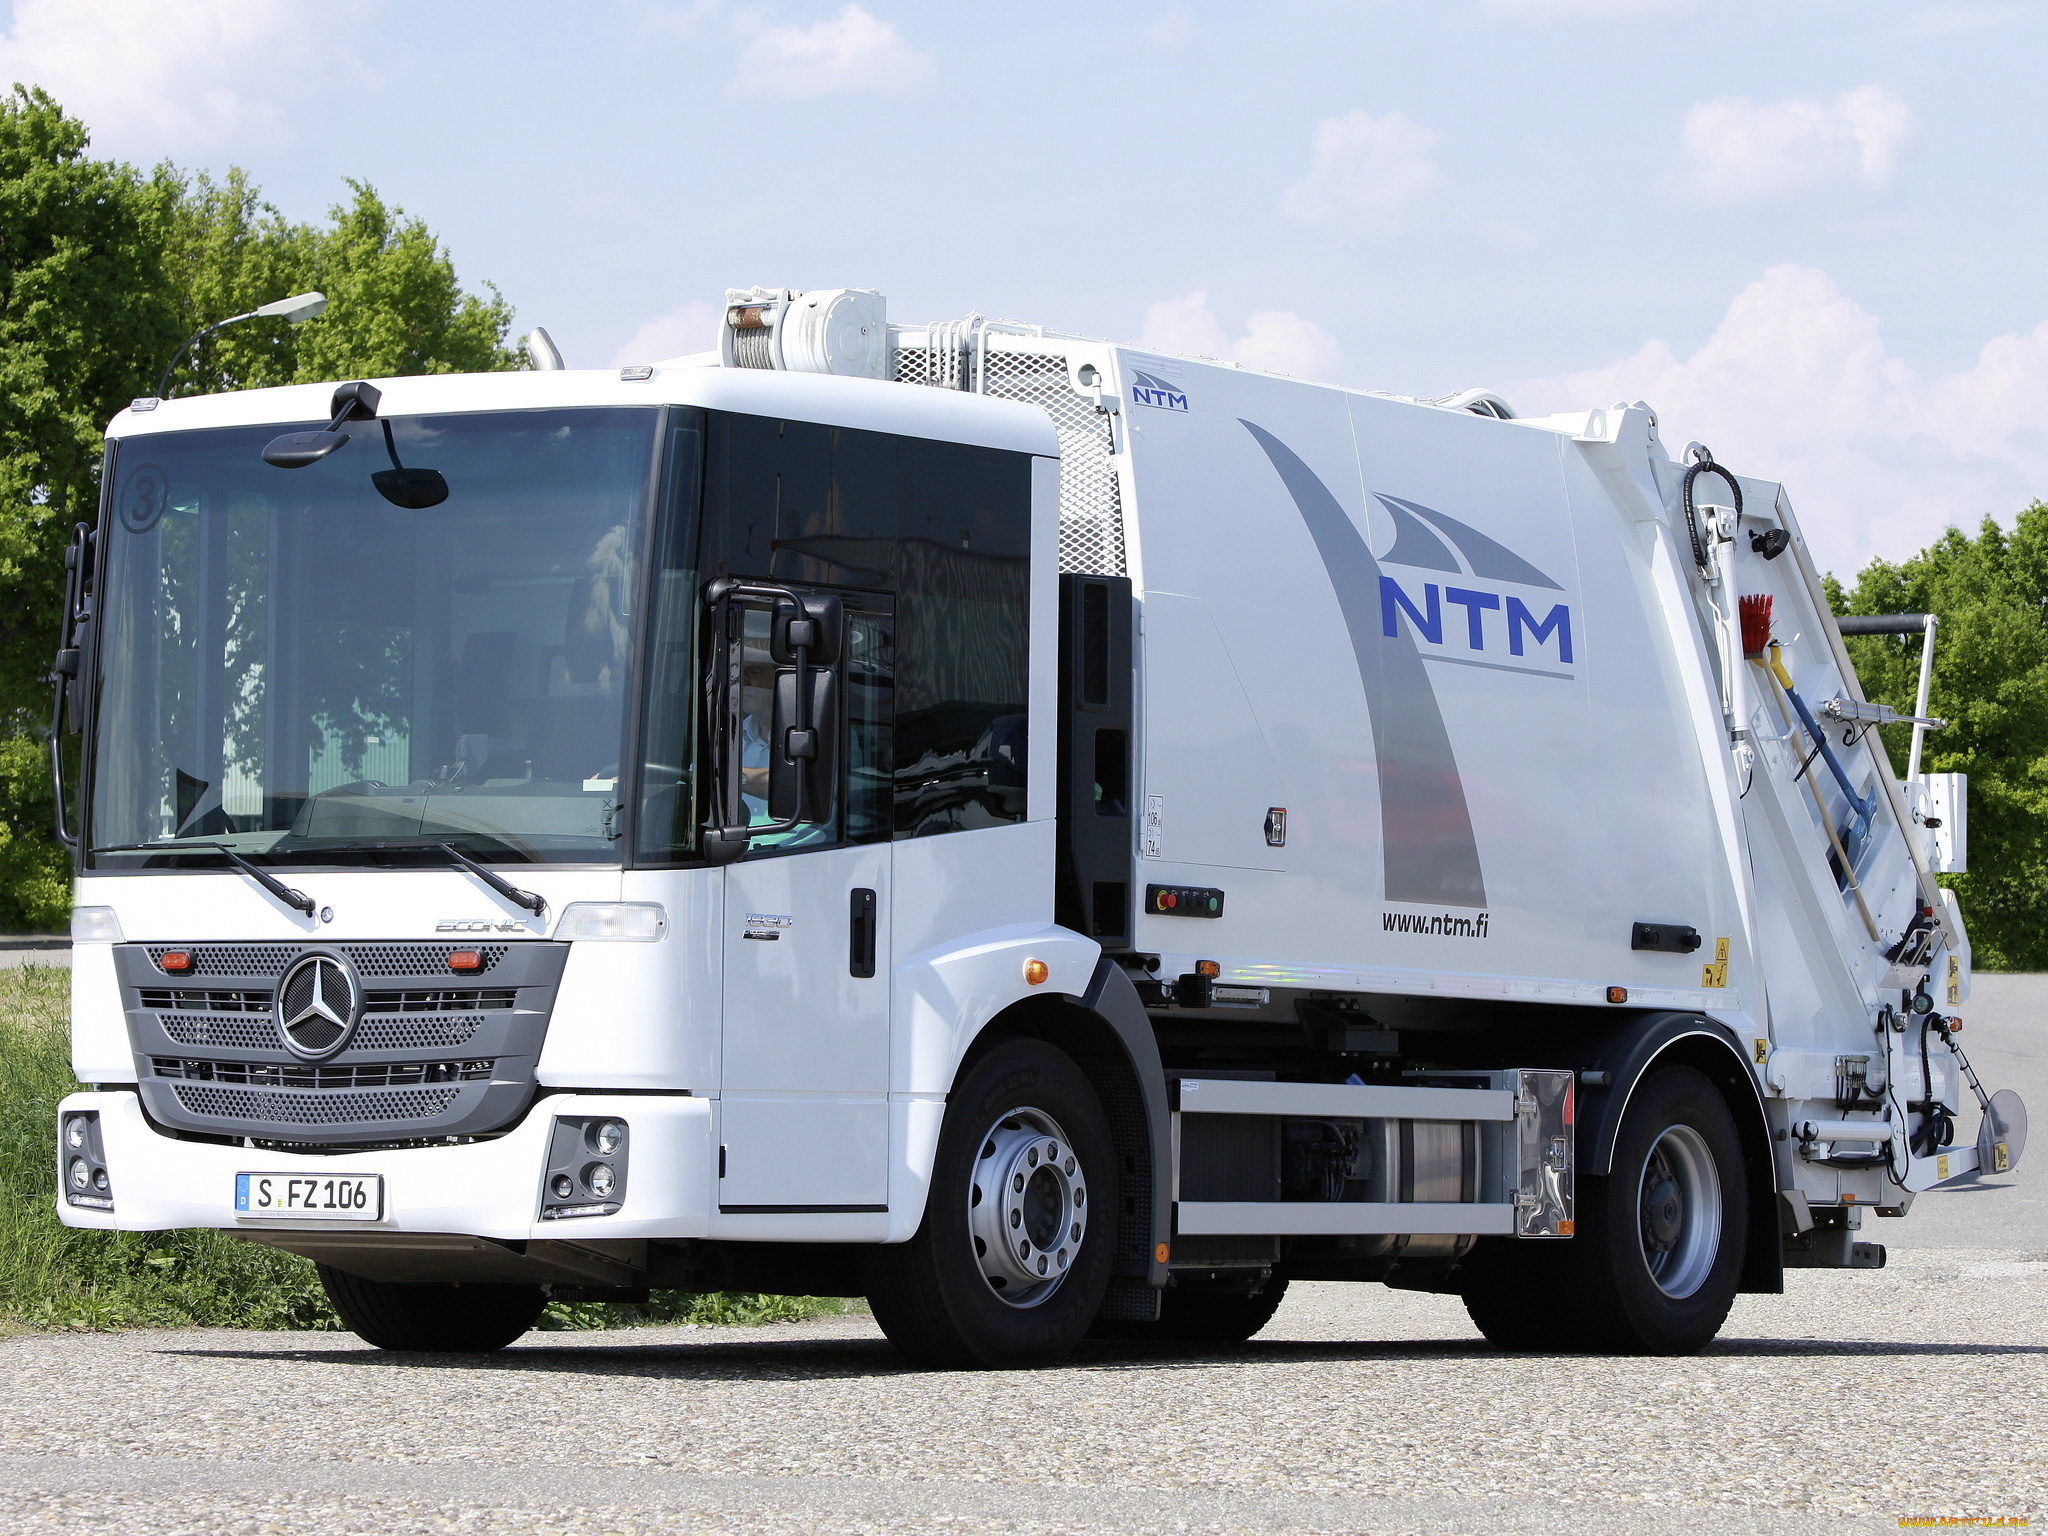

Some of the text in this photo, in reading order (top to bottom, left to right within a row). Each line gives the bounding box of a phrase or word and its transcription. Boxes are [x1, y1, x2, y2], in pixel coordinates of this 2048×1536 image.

[1132, 386, 1189, 410] NTM
[132, 476, 155, 522] 3
[1378, 575, 1575, 664] NTM
[1147, 840, 1155, 855] 74
[435, 918, 530, 932] ECONIC
[1382, 912, 1489, 938] www.ntm.fi
[240, 1197, 247, 1205] D
[257, 1179, 273, 1208] S
